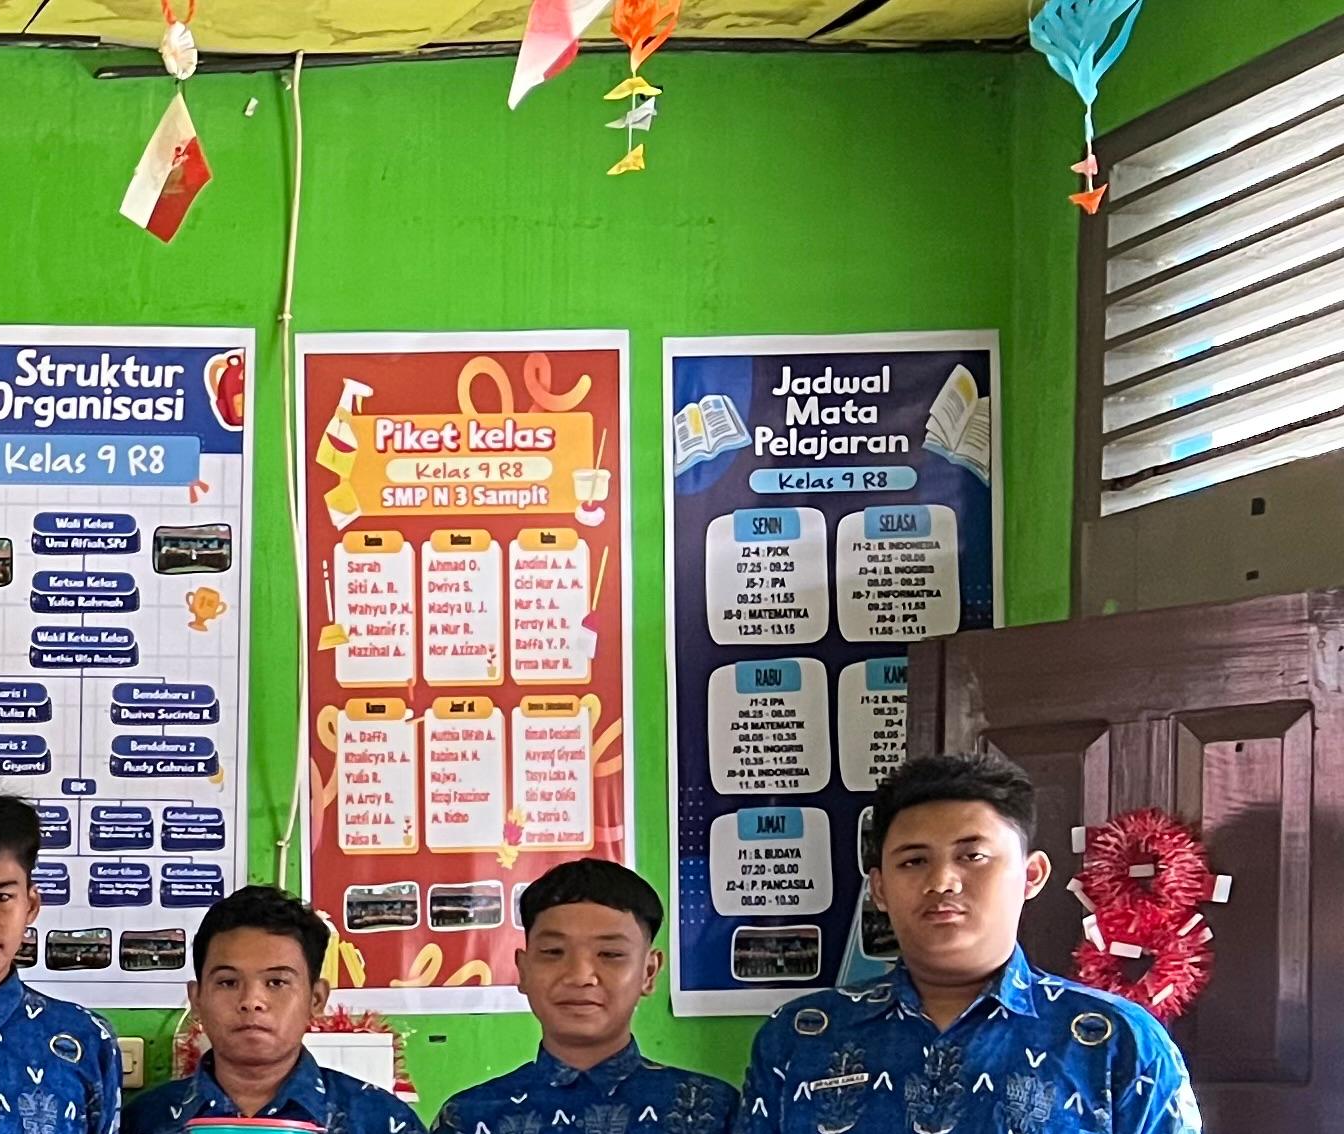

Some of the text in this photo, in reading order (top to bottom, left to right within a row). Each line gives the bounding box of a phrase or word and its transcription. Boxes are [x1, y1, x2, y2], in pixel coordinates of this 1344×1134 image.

[15, 349, 184, 388] Struktur
[772, 366, 890, 395] Jadwal
[786, 396, 878, 425] Mata
[375, 418, 555, 452] Piket kelas
[755, 427, 909, 460] Pelajaran
[4, 443, 165, 476] Kelas 9 R8
[416, 462, 523, 479] Kelas 9 R8
[779, 472, 887, 490] Kelas 9 R8
[381, 485, 549, 509] SMP N 3 Sampit
[83, 518, 114, 529] Kelas
[753, 517, 782, 534] SENIN
[880, 515, 916, 532] SELASA
[348, 561, 381, 573] Sarah
[428, 560, 465, 572] Ahmad
[87, 577, 117, 588] Kelas
[348, 580, 367, 594] Siti
[464, 581, 473, 592] S.
[771, 578, 786, 587] IPA
[47, 596, 75, 607] Yulia
[348, 604, 387, 617] Wahyu
[428, 602, 461, 616] Nadya
[756, 669, 781, 686] RABU
[133, 688, 189, 699] Bendahara
[360, 731, 387, 742] Daffa
[131, 740, 187, 752] Bendahara
[756, 816, 785, 833] JUMAT
[765, 848, 801, 859] BUDAYA
[762, 879, 814, 890] PANCASILA
